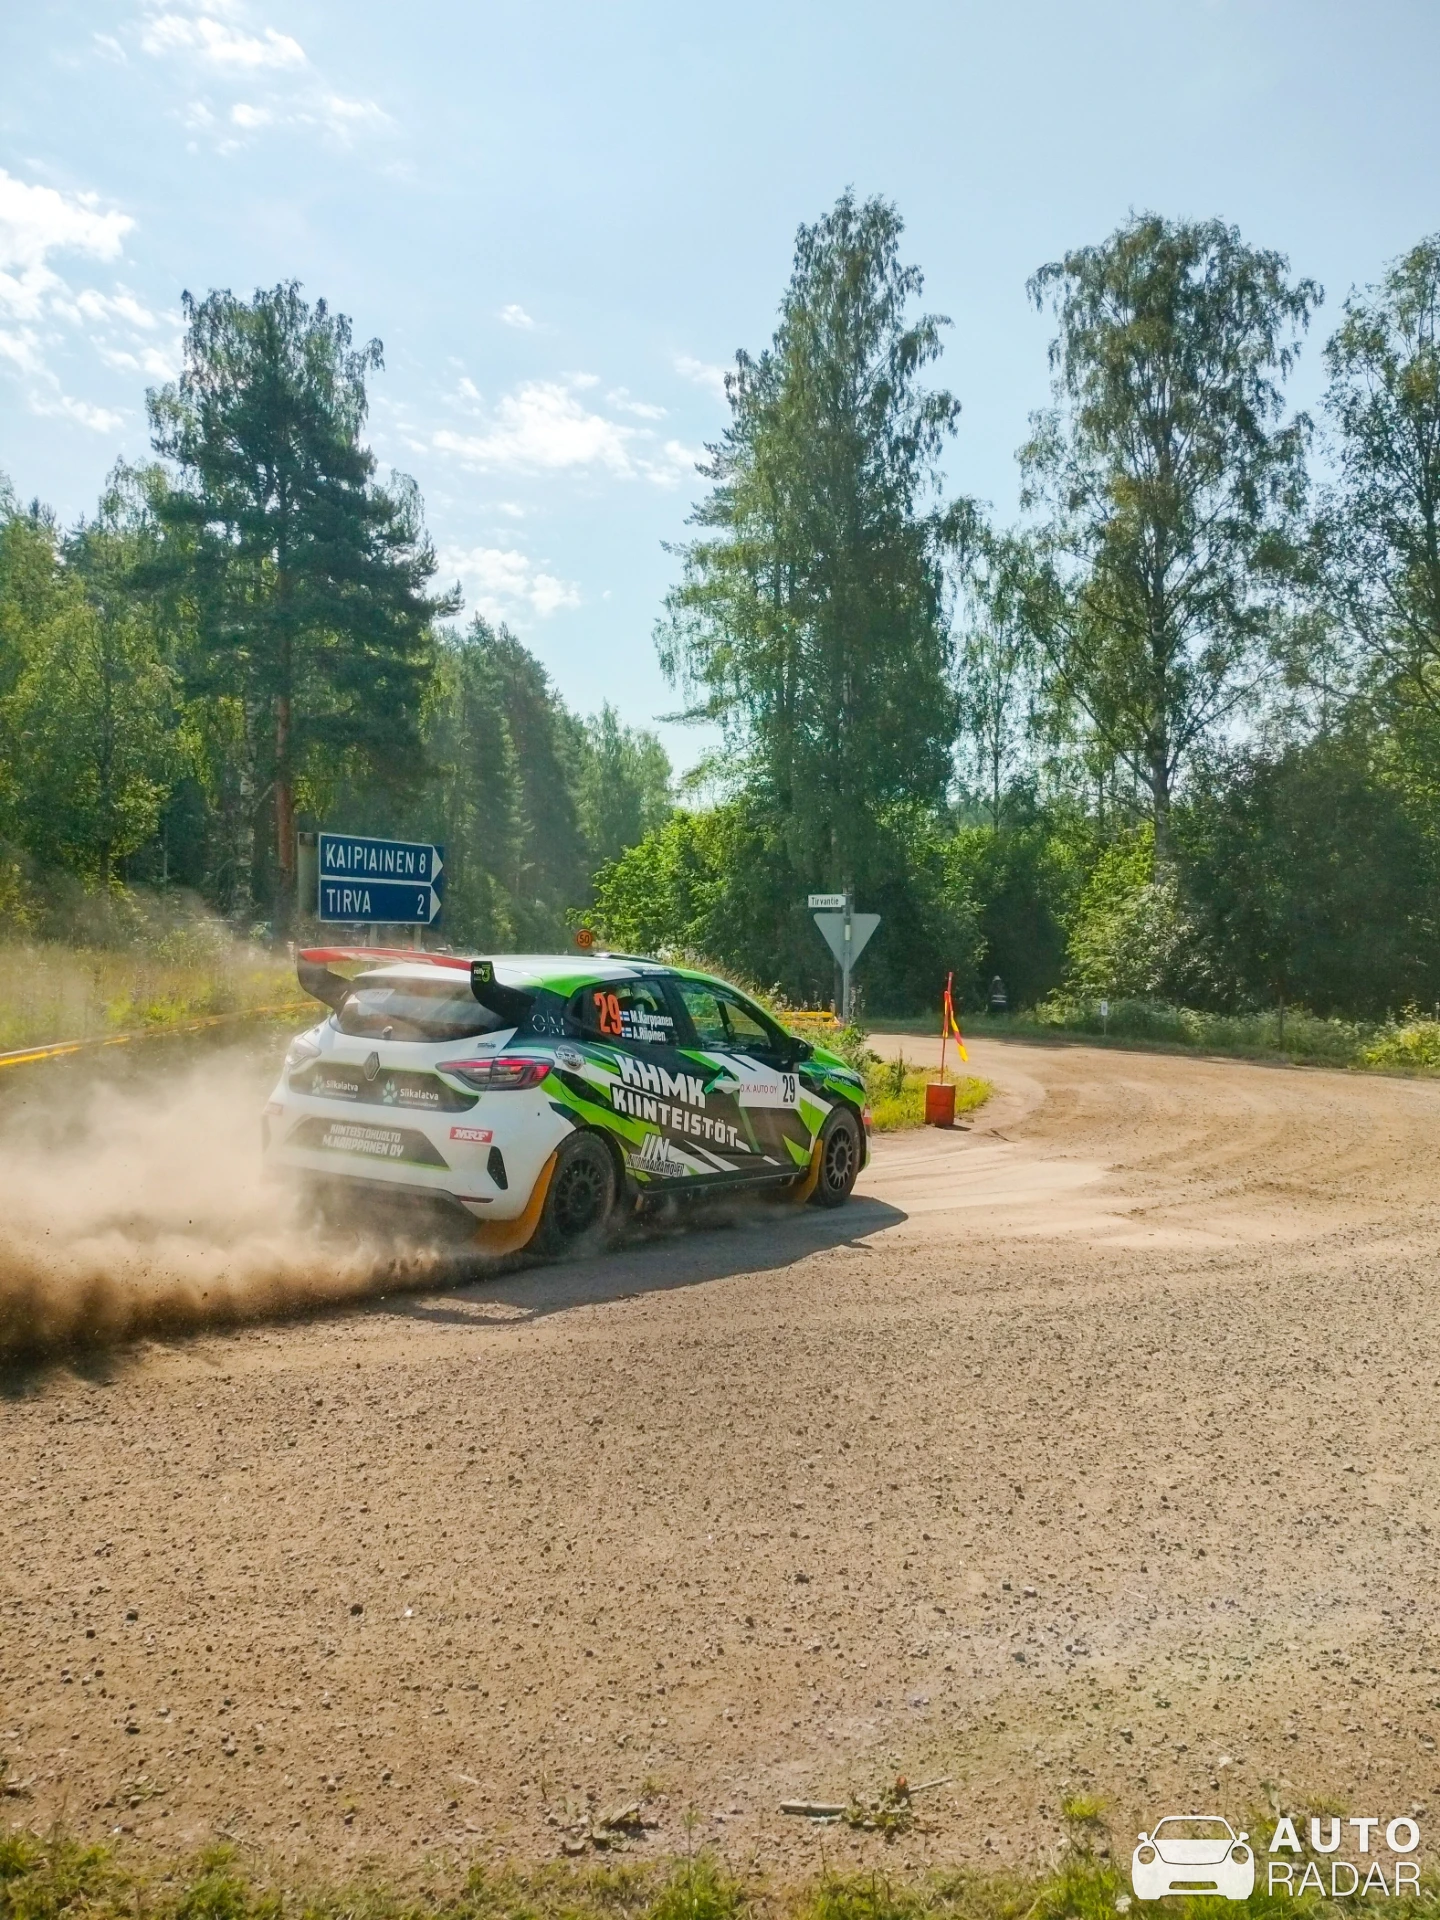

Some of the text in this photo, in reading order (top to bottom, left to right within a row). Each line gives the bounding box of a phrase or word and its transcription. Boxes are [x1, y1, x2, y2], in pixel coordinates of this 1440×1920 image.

[326, 843, 426, 874] KAIPIAINEN 8
[326, 889, 424, 915] TIRVA 2
[811, 897, 839, 905] Tirvantie
[580, 935, 590, 944] 50
[594, 992, 622, 1034] 29
[326, 1080, 359, 1092] Siikalatva
[613, 1054, 706, 1109] KHMK
[400, 1088, 439, 1101] Siikalatva
[753, 1084, 769, 1094] AUTO
[770, 1085, 778, 1094] OY
[782, 1075, 796, 1103] 29
[612, 1086, 738, 1147] KIINTEISTÖT
[453, 1129, 489, 1141] MRF
[389, 1144, 404, 1157] OY
